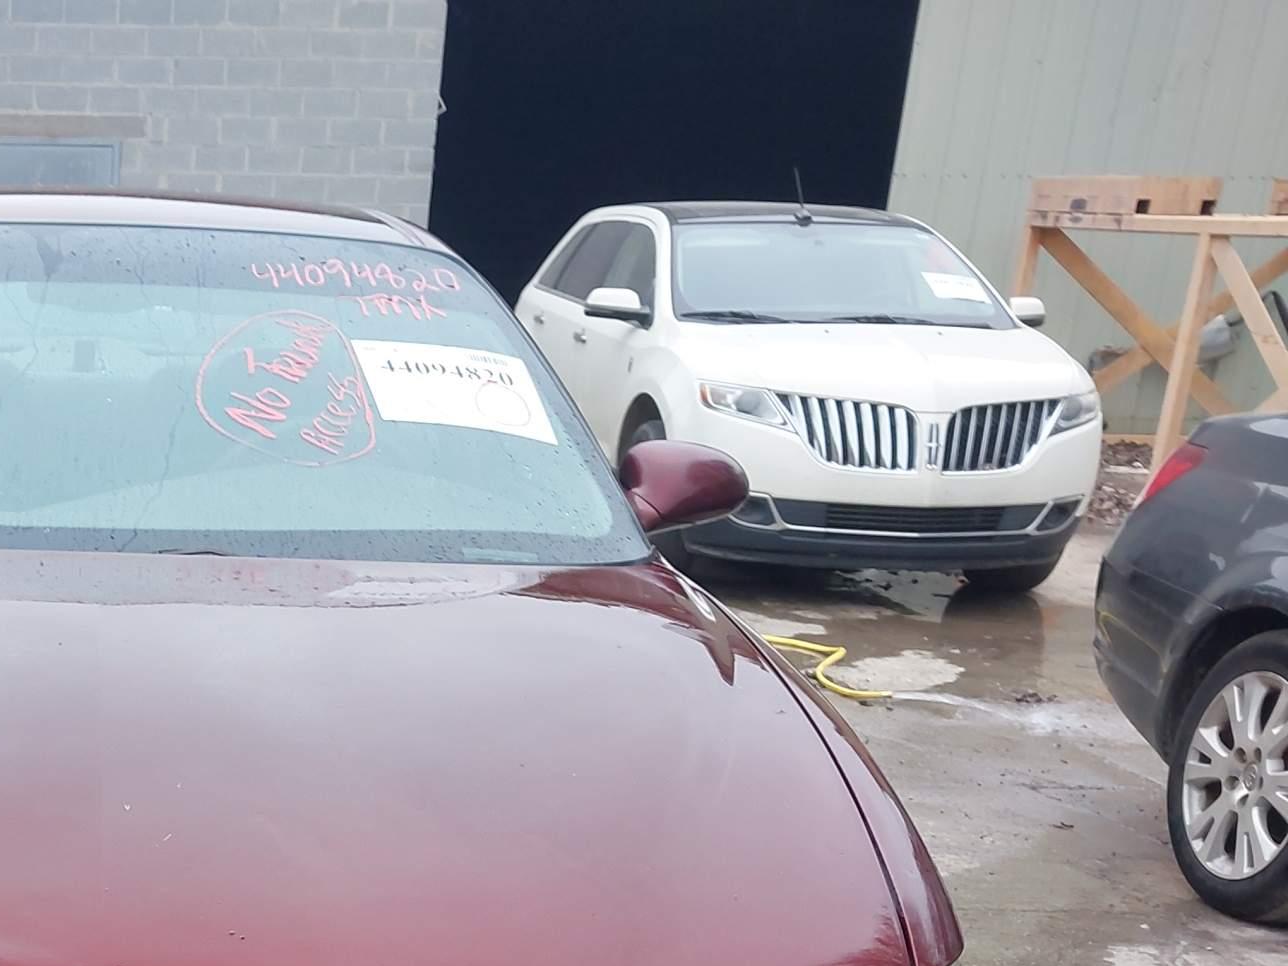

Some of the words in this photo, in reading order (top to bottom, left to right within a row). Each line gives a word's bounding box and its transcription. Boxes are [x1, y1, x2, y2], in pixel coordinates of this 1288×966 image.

[250, 257, 462, 292] 44094820
[380, 359, 515, 387] 44094820
[223, 386, 292, 440] No
